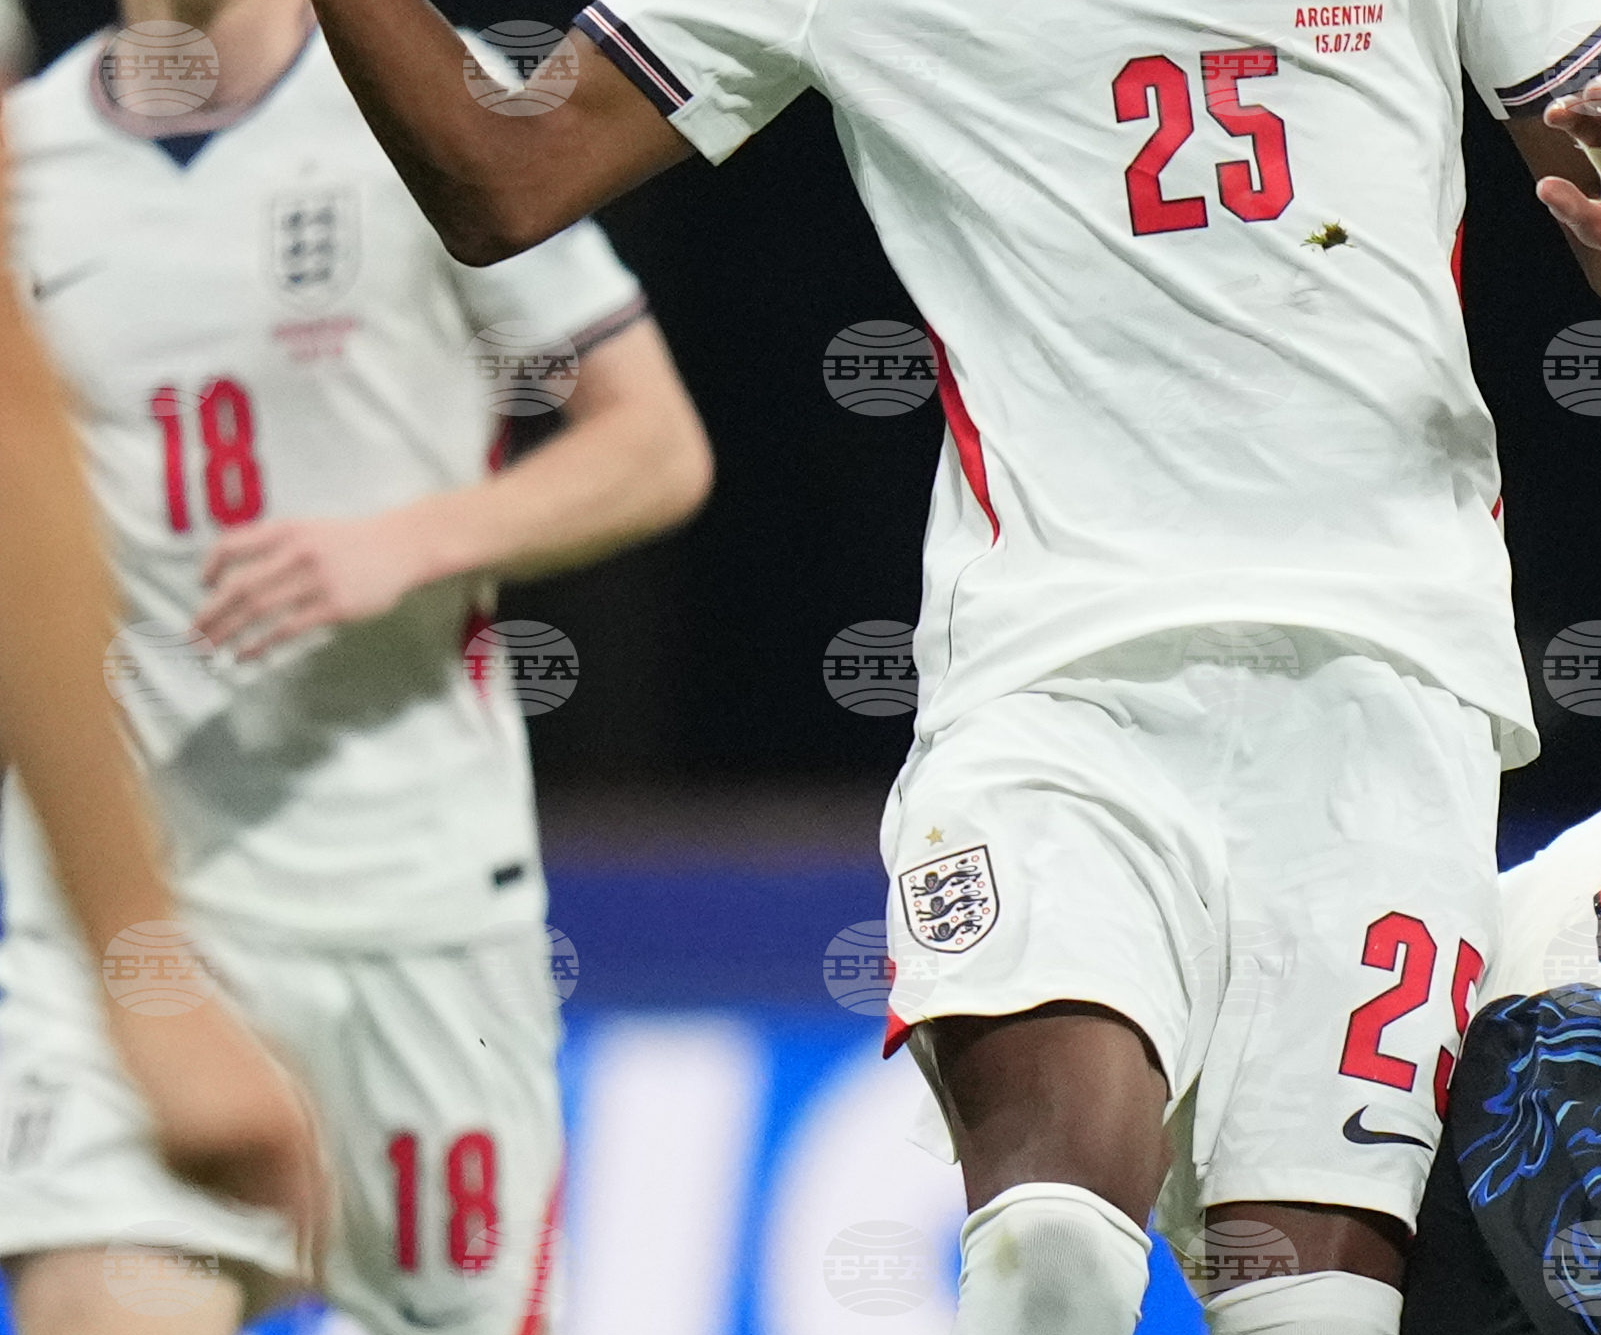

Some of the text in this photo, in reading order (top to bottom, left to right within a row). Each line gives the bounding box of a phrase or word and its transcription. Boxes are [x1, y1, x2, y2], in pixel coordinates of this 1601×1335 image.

[1295, 3, 1383, 27] ARGENTINA
[1316, 32, 1372, 53] 15.07.26
[1112, 46, 1294, 236] 25
[148, 374, 264, 533] 18
[388, 1129, 500, 1274] 18
